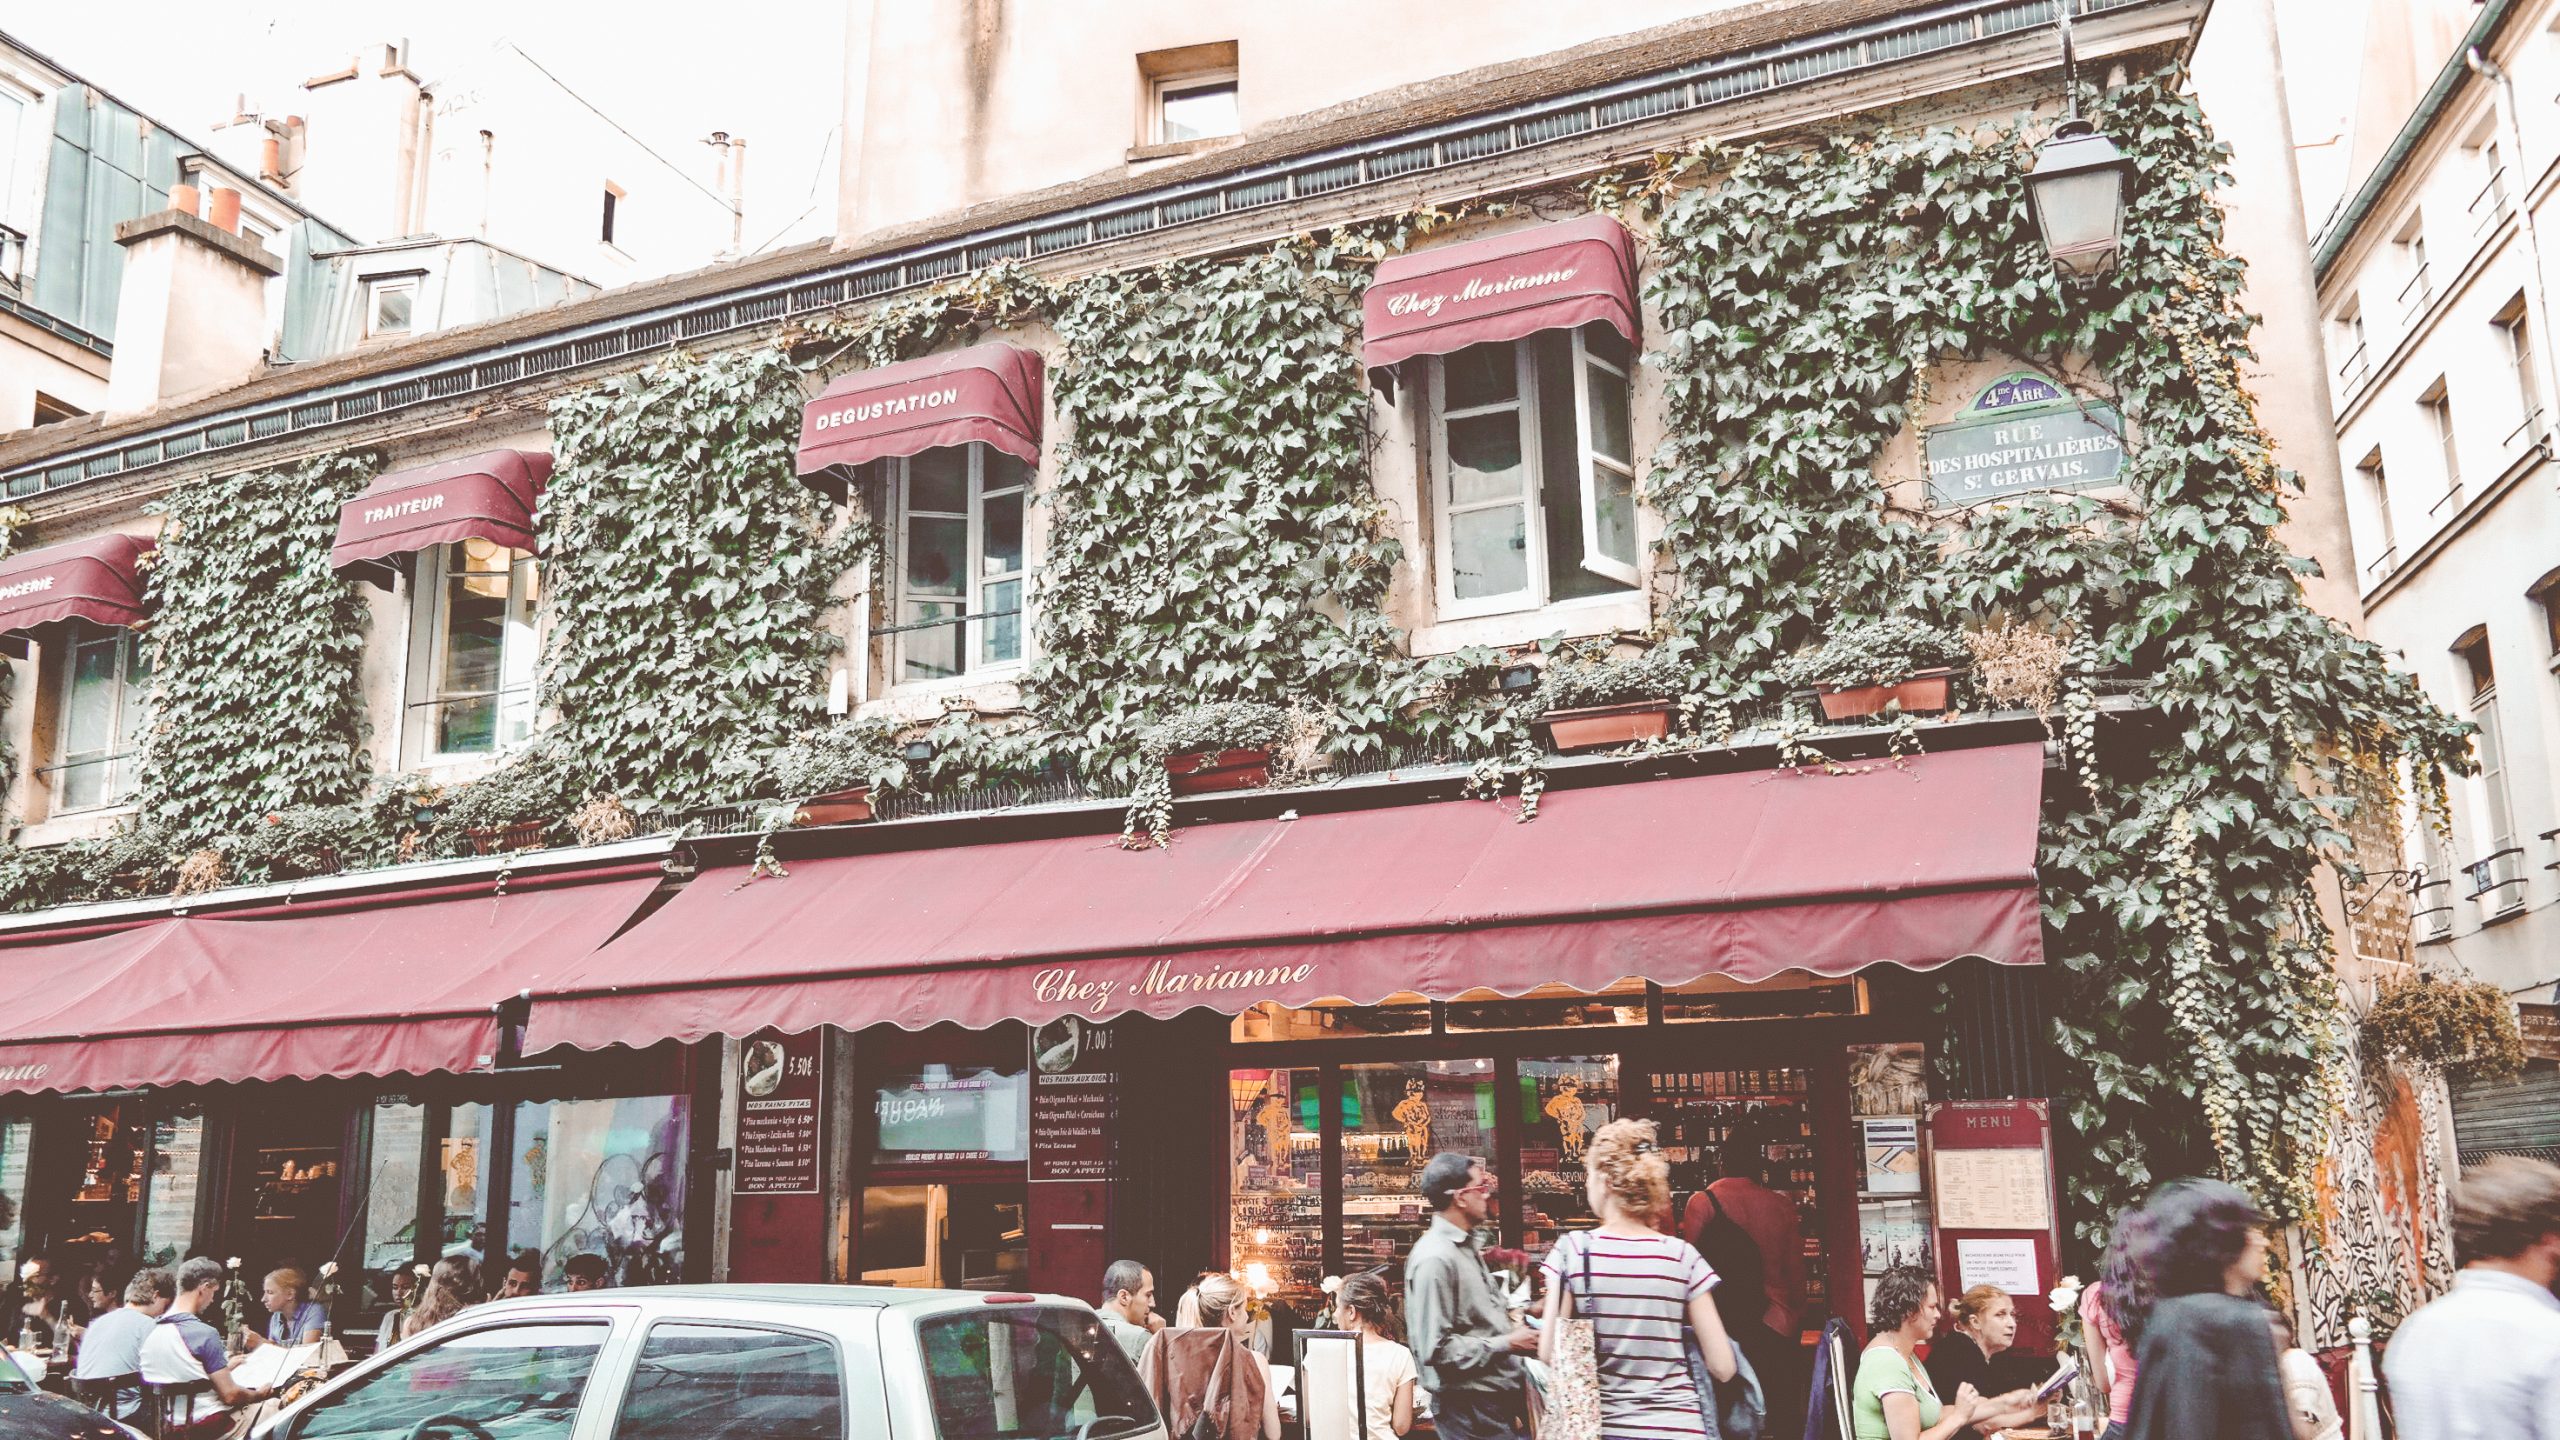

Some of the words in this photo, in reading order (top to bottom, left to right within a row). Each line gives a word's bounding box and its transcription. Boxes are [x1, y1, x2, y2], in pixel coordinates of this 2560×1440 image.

[1387, 294, 1448, 317] Chez
[1453, 267, 1578, 303] Marianne
[815, 388, 958, 431] DEGUSTATION
[1994, 424, 2043, 446] RUE
[1929, 457, 1961, 476] DES
[1964, 434, 2120, 471] HOSPITALIÈRES
[364, 494, 445, 525] TRAITEUR
[1032, 968, 1120, 1014] Chez
[1129, 959, 1319, 997] Marianne
[788, 1055, 814, 1077] 5.50€
[1040, 1075, 1053, 1083] NOS
[1054, 1075, 1075, 1083] PAINS
[747, 1101, 763, 1109] NOS
[1966, 1116, 2012, 1128] MENU
[1562, 1171, 1588, 1182] DEVENU
